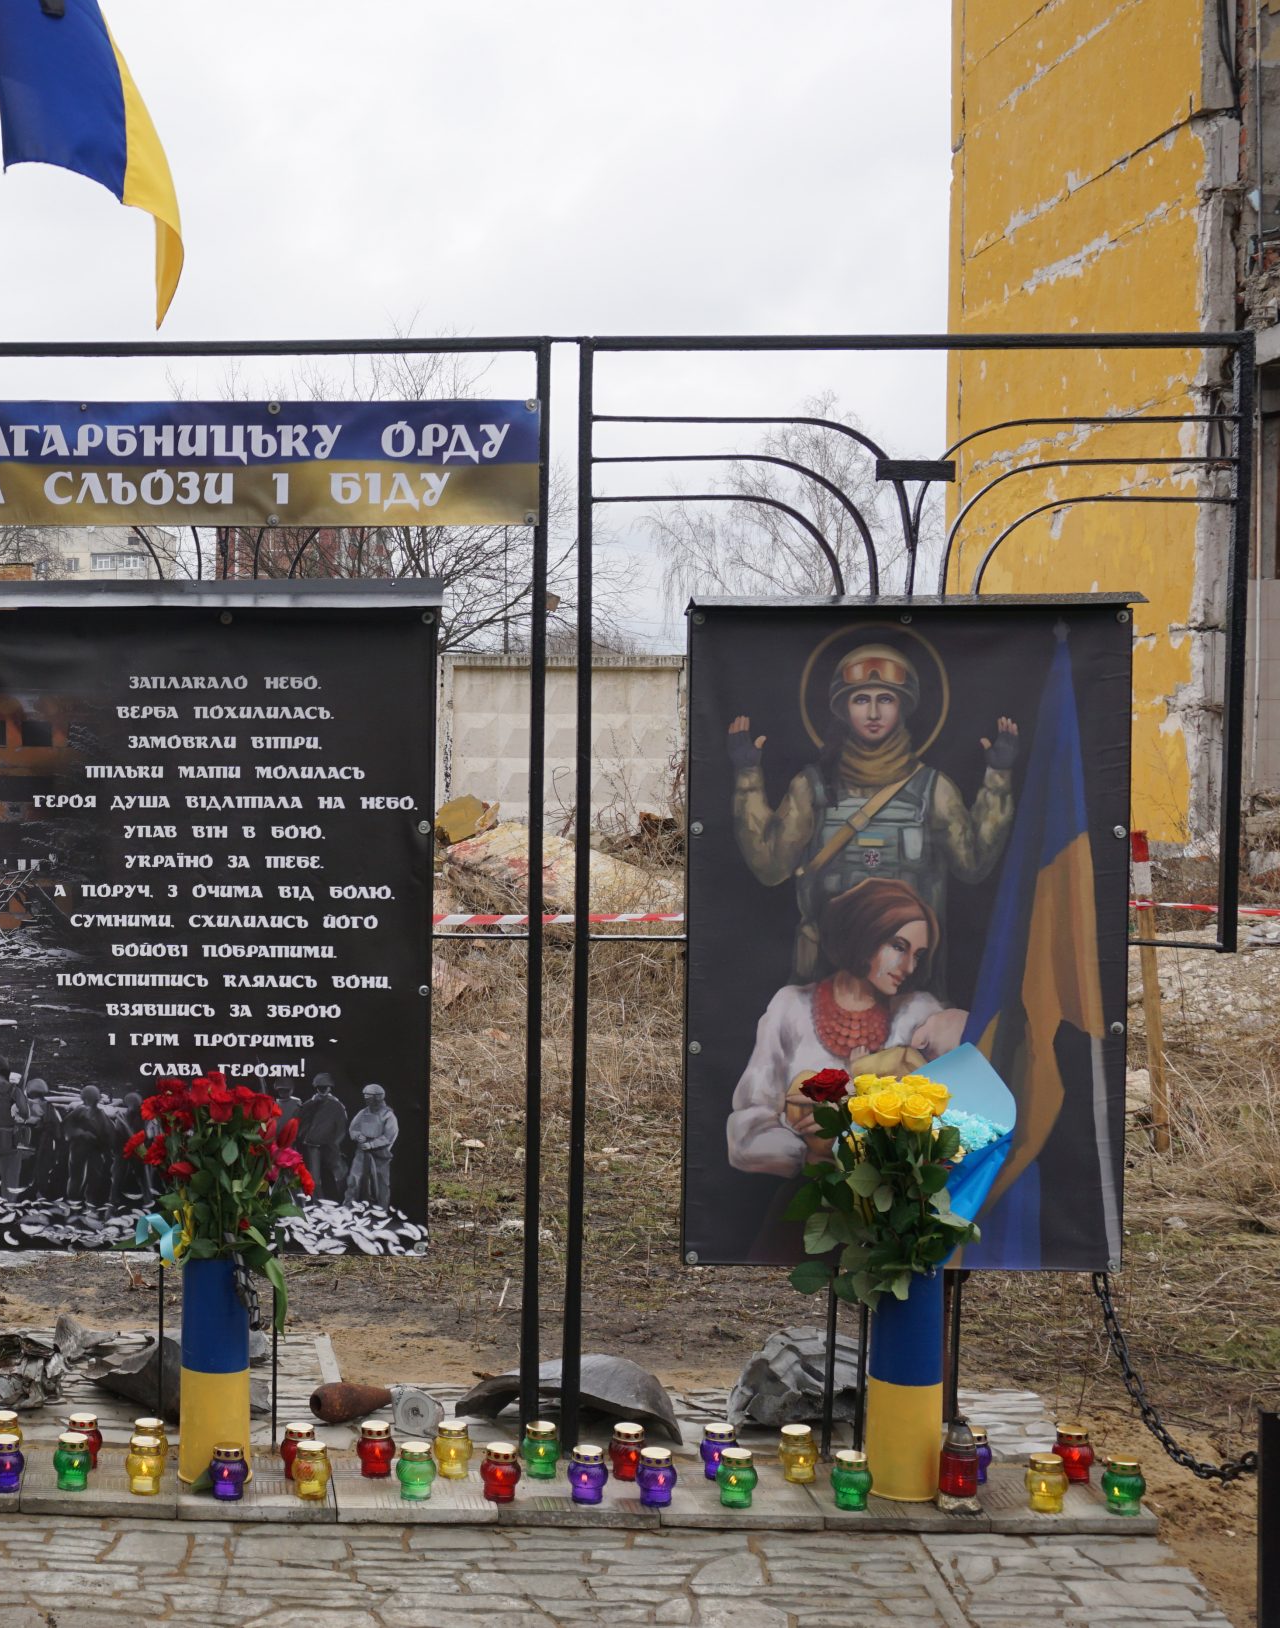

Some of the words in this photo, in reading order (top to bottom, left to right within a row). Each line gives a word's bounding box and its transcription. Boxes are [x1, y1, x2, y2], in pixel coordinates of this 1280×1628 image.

[381, 421, 511, 465] ОРДУ
[43, 468, 234, 506] СЛЬОЗИ
[272, 472, 289, 505] І
[330, 472, 451, 513] БІДУ
[128, 675, 248, 690] ЗАПЛАКАЛО
[264, 675, 322, 690] НЕБО.
[116, 705, 179, 719] ВЕРБА
[193, 704, 335, 720] ПОХИЛИЛАСЬ.
[127, 734, 237, 750] ЗАМОВКЛИ
[84, 765, 164, 779] ТІЛЬКИ
[177, 765, 241, 779] МАТИ
[254, 764, 366, 780] МОЛИЛАСЬ
[33, 793, 97, 809] ГЕРОЯ
[110, 795, 171, 811] ДУША
[185, 795, 304, 811] ВІДЛІТАЛА
[317, 796, 346, 810] НА
[123, 825, 178, 839] УПАВ
[191, 825, 228, 839] ВІН
[241, 825, 256, 839] В
[124, 852, 214, 869] УКРАЇНО
[227, 854, 251, 869] ЗА
[53, 884, 67, 898] А
[167, 884, 178, 898] З
[191, 883, 264, 899] ОЧИМА
[277, 885, 315, 902] ВІД
[188, 914, 309, 929] СХИЛИЛИСЬ
[322, 913, 379, 930] ЙОГО
[111, 942, 188, 958] БОЙОВІ
[201, 943, 338, 959] ПОБРАТИМИ.
[56, 972, 209, 988] ПОМСТИТИСЬ
[222, 974, 318, 989] КЛЯЛИСЬ
[105, 1002, 216, 1018] ВЗЯВШИСЬ
[229, 1003, 253, 1018] ЗА
[266, 1003, 342, 1019] ЗБРОЮ
[107, 1032, 116, 1046] І
[129, 1032, 180, 1047] ГРІМ
[193, 1032, 315, 1048] ПРОГРИМІВ
[139, 1062, 204, 1077] СЛАВА
[217, 1057, 306, 1078] ГЕРОЯМ!
